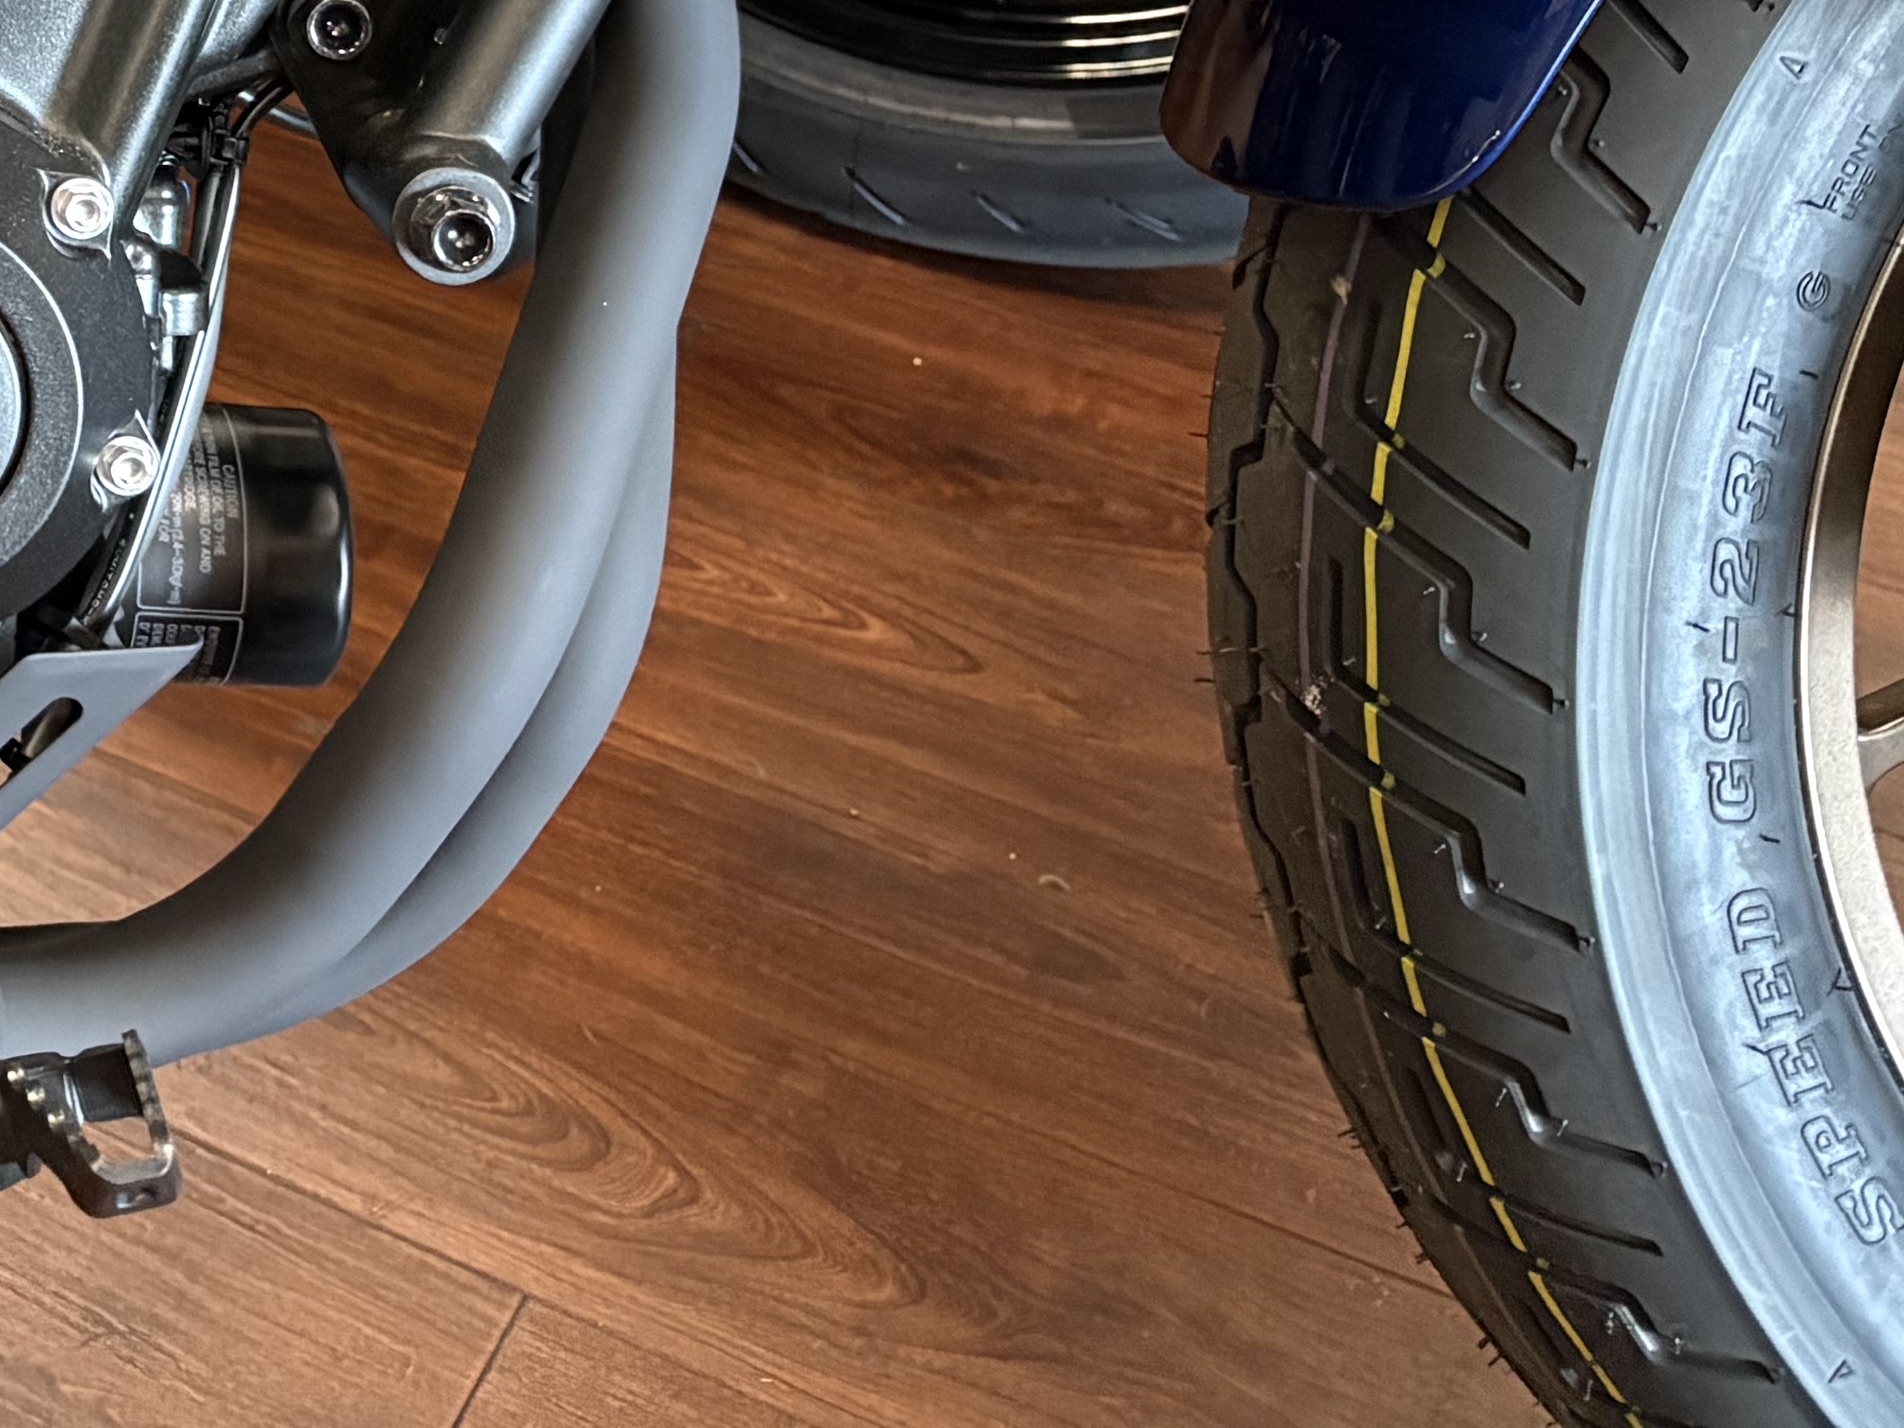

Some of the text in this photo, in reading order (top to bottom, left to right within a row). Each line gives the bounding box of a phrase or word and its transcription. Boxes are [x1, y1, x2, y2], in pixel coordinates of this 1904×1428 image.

[1824, 123, 1880, 214] FRONT
[1840, 165, 1878, 221] USE
[211, 495, 225, 513] OIL
[222, 464, 239, 519] CAUTION
[199, 527, 212, 545] ON
[213, 517, 226, 533] TO
[198, 547, 212, 573] AND
[213, 535, 227, 557] THE
[1703, 366, 1789, 825] GS-23F
[1725, 886, 1904, 1248] SPEED
